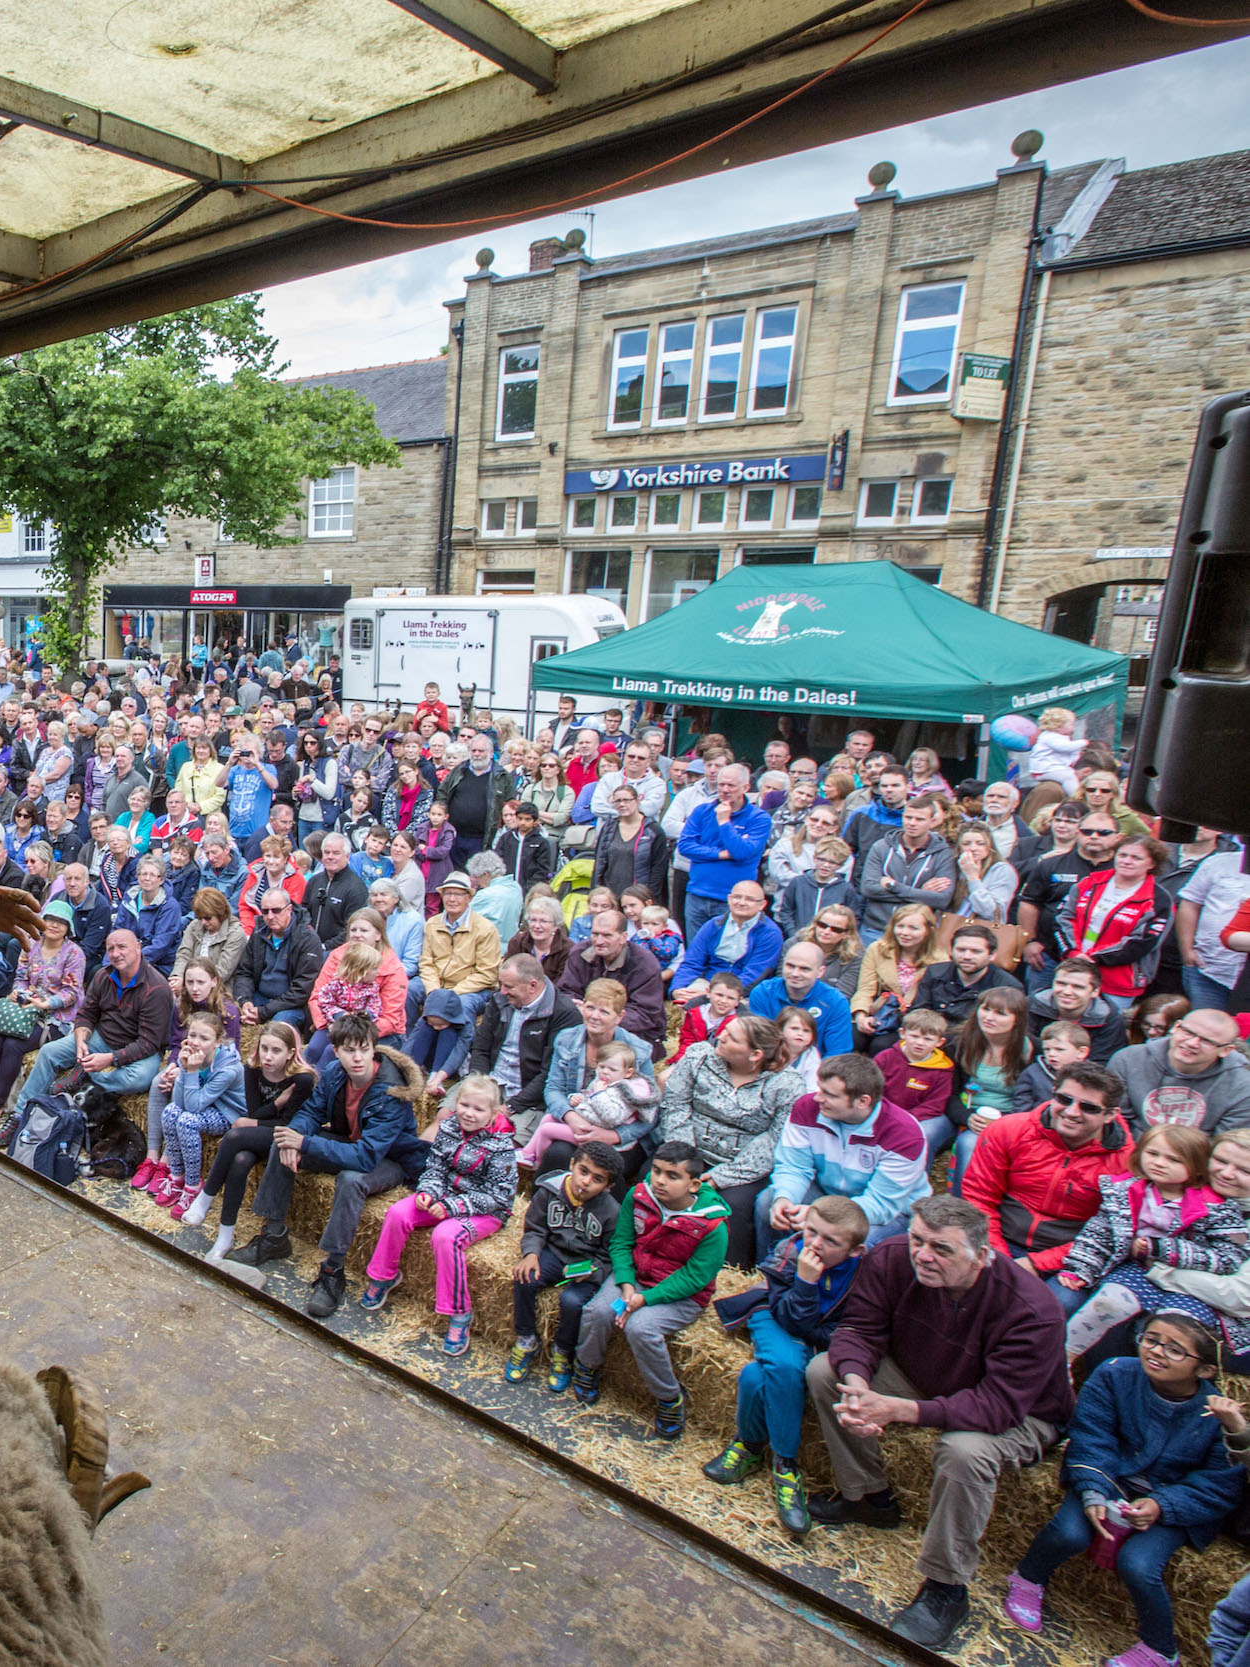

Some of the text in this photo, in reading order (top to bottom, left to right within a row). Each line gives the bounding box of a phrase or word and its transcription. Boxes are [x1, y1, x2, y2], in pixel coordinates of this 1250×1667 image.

[983, 367, 999, 379] LET
[623, 458, 790, 488] Yorkshire Bank
[198, 593, 234, 602] TOG24
[403, 620, 467, 631] Llama Trekking
[409, 629, 459, 638] in the Dales
[612, 677, 857, 706] Llama Trekking in the Dales!
[547, 1200, 603, 1240] GAP
